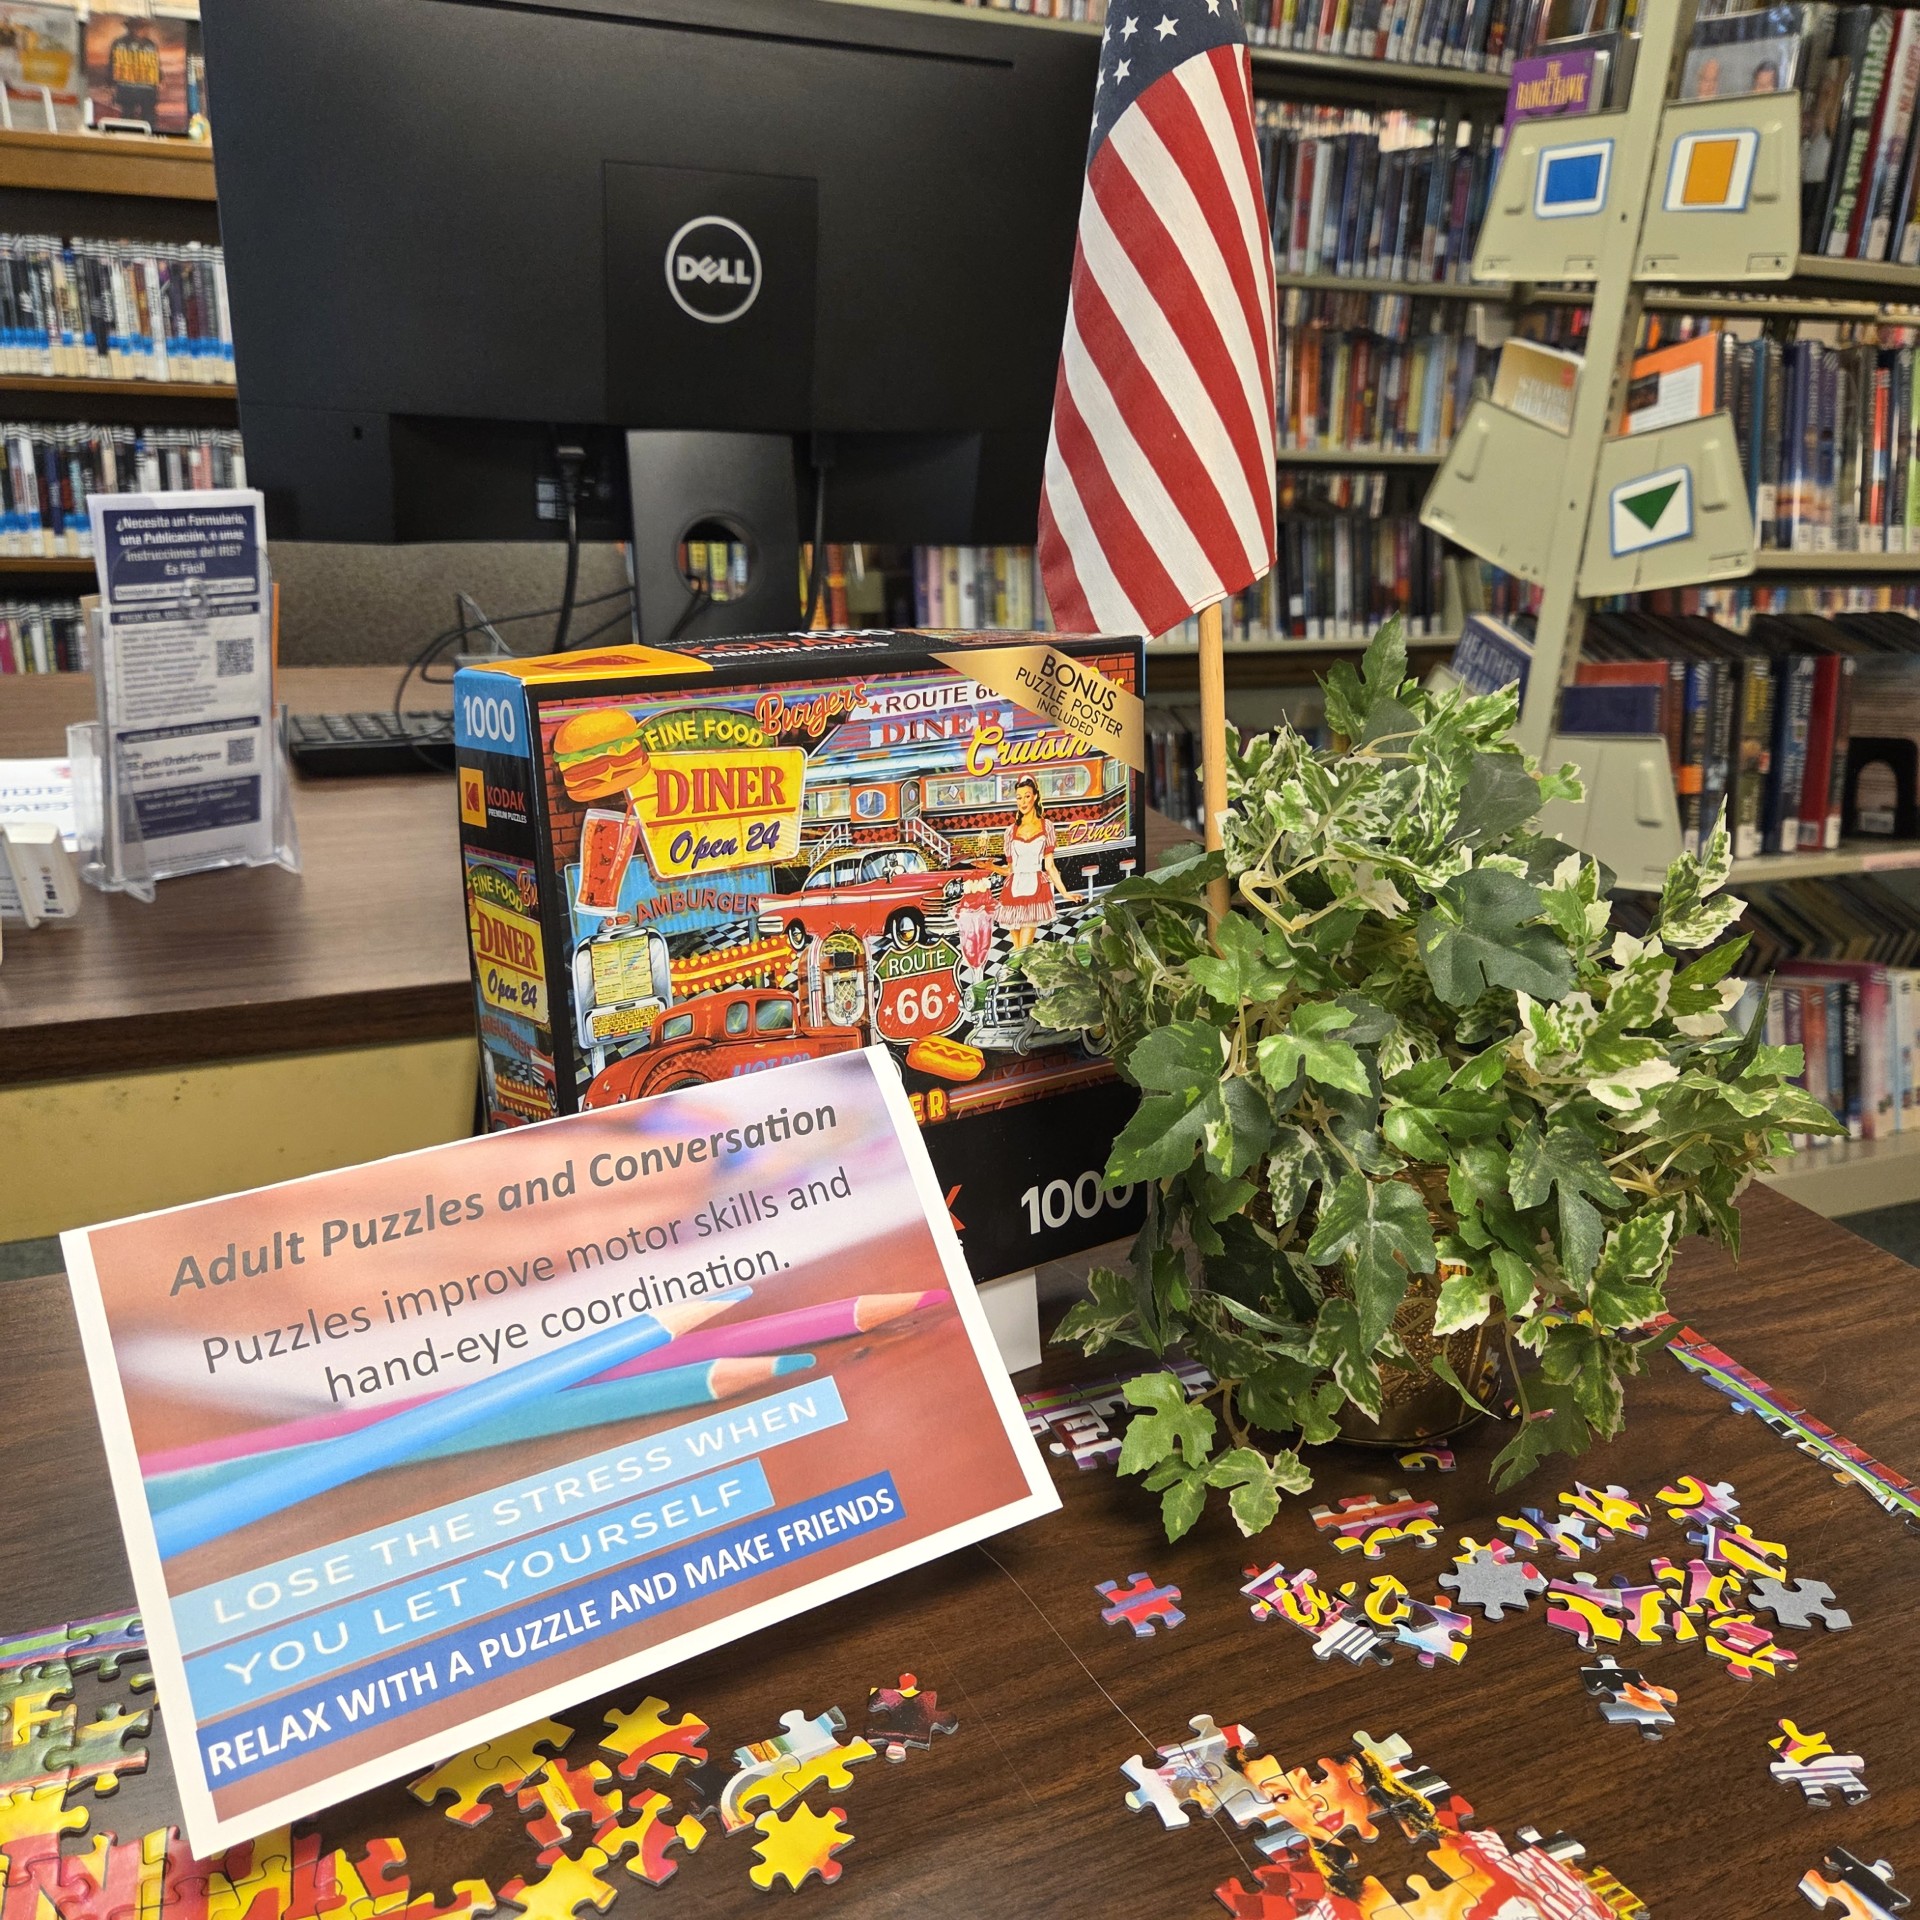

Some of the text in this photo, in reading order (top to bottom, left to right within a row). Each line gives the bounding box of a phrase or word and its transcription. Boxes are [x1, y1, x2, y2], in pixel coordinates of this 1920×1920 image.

[677, 255, 751, 285] DELL
[172, 517, 187, 527] un
[678, 635, 874, 655] KODAK
[699, 641, 889, 660] PREMIUM PUZZLES
[787, 628, 895, 639] 1000
[886, 686, 968, 714] ROUTE
[1016, 666, 1122, 738] PUZZLE POSTER
[1040, 654, 1117, 711] BONUS
[462, 694, 516, 743] 1000
[754, 682, 868, 737] Burgers
[880, 708, 1001, 746] DINER
[1036, 698, 1094, 736] INCLUDED
[645, 720, 764, 750] FINE FOOD
[486, 785, 525, 812] KODAK
[655, 766, 786, 817] DINER
[488, 808, 527, 824] PREMIUM PUZZLES
[1068, 820, 1125, 844] Diner
[670, 821, 781, 868] Open 24
[471, 873, 523, 912] FINE FOOD
[478, 909, 537, 972] DINER
[888, 948, 947, 974] ROUTE
[488, 968, 538, 1006] Open 24
[896, 983, 944, 1025] 66
[170, 1104, 837, 1297] Adult Puzzles and Conversation
[203, 1166, 852, 1374] Puzzles improve motor skills and
[324, 1248, 791, 1403] hand-eye coordination.
[214, 1396, 817, 1624] LOSE THE STRESS WHEN
[223, 1479, 743, 1686] YOU LET YOURSELF
[207, 1488, 895, 1776] RELAX WITH A PUZZLE AND MAKE FRIENDS
